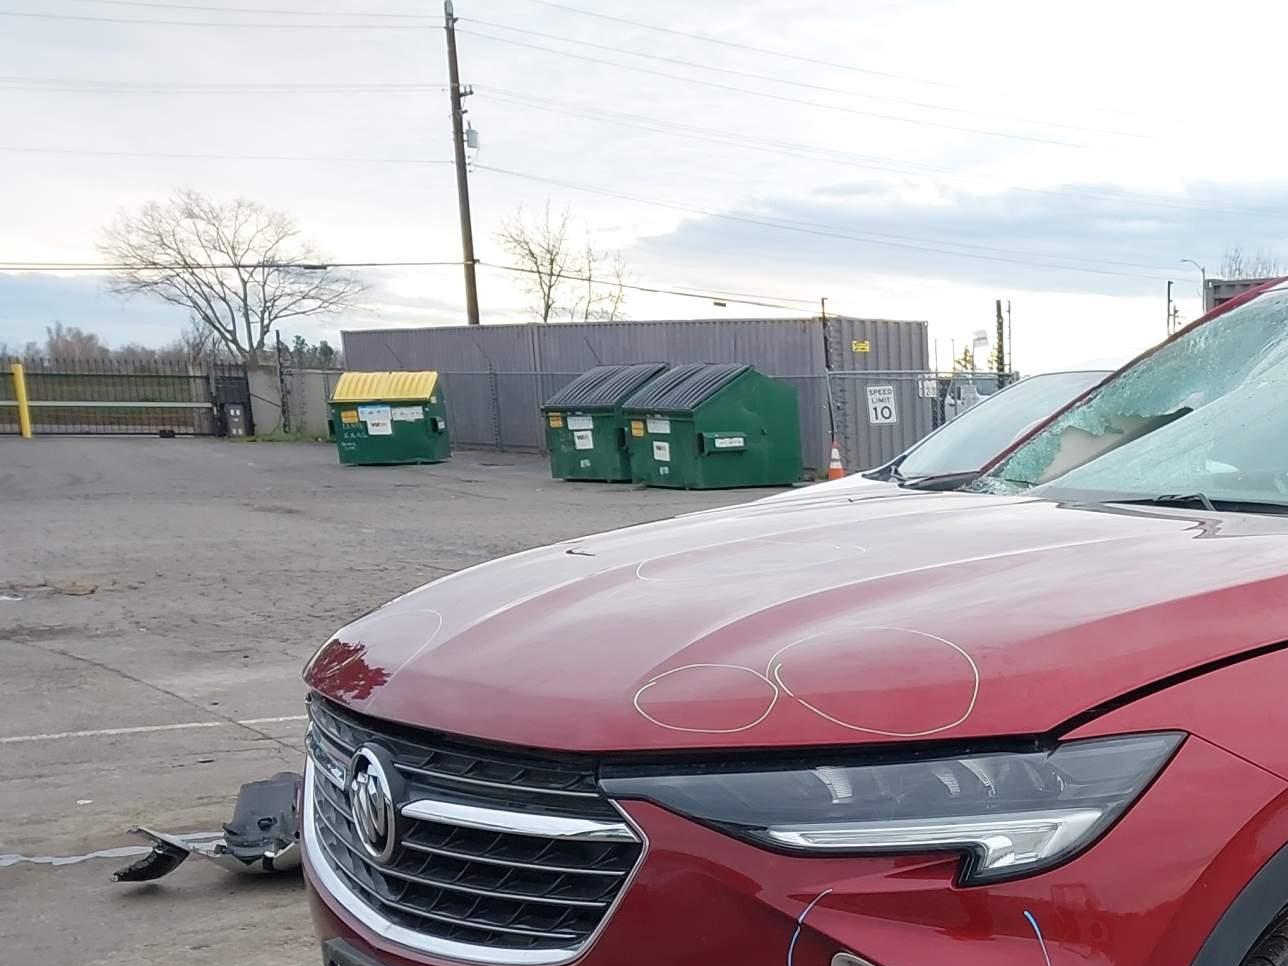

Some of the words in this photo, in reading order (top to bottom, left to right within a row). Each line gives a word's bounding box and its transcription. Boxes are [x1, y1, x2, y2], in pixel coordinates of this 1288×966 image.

[868, 389, 893, 397] SPEED
[871, 397, 891, 405] LIMIT
[873, 406, 893, 421] 10
